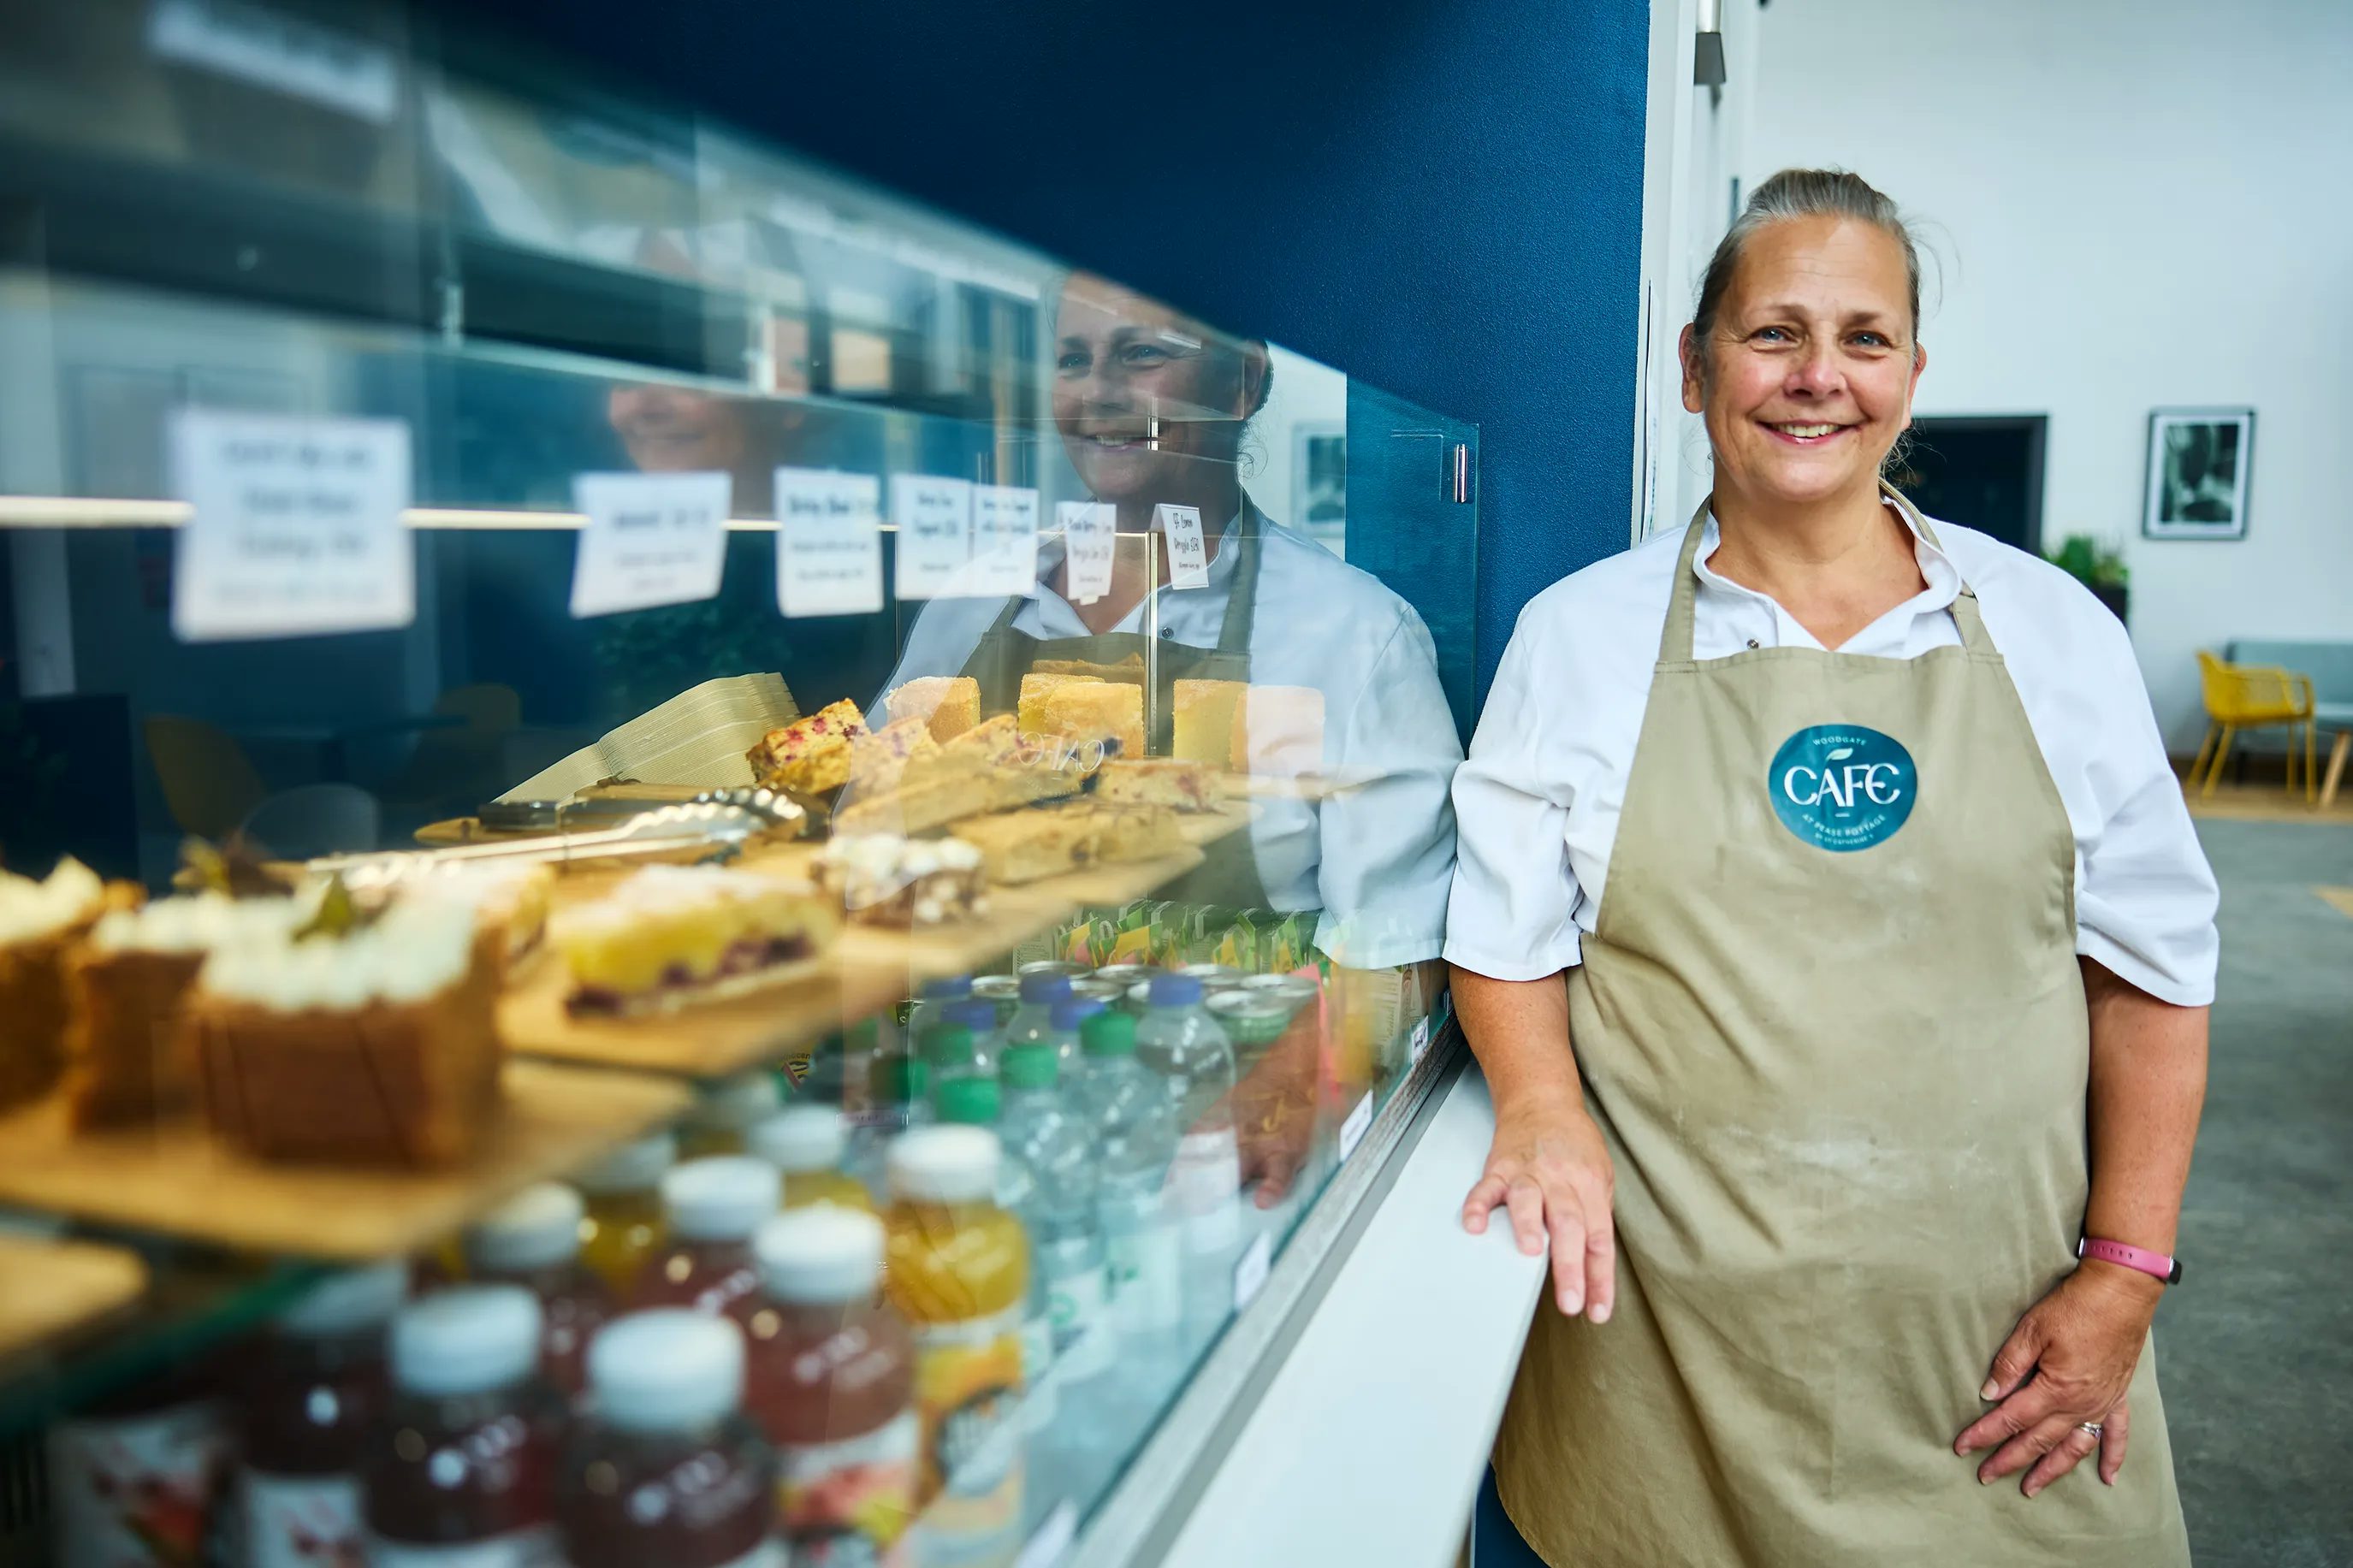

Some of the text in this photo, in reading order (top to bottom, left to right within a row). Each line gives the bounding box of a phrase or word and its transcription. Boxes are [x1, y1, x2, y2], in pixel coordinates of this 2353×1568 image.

[1812, 735, 1867, 746] WOODGATE
[1783, 762, 1901, 808] CAFE
[1844, 814, 1887, 837] POTTAGE
